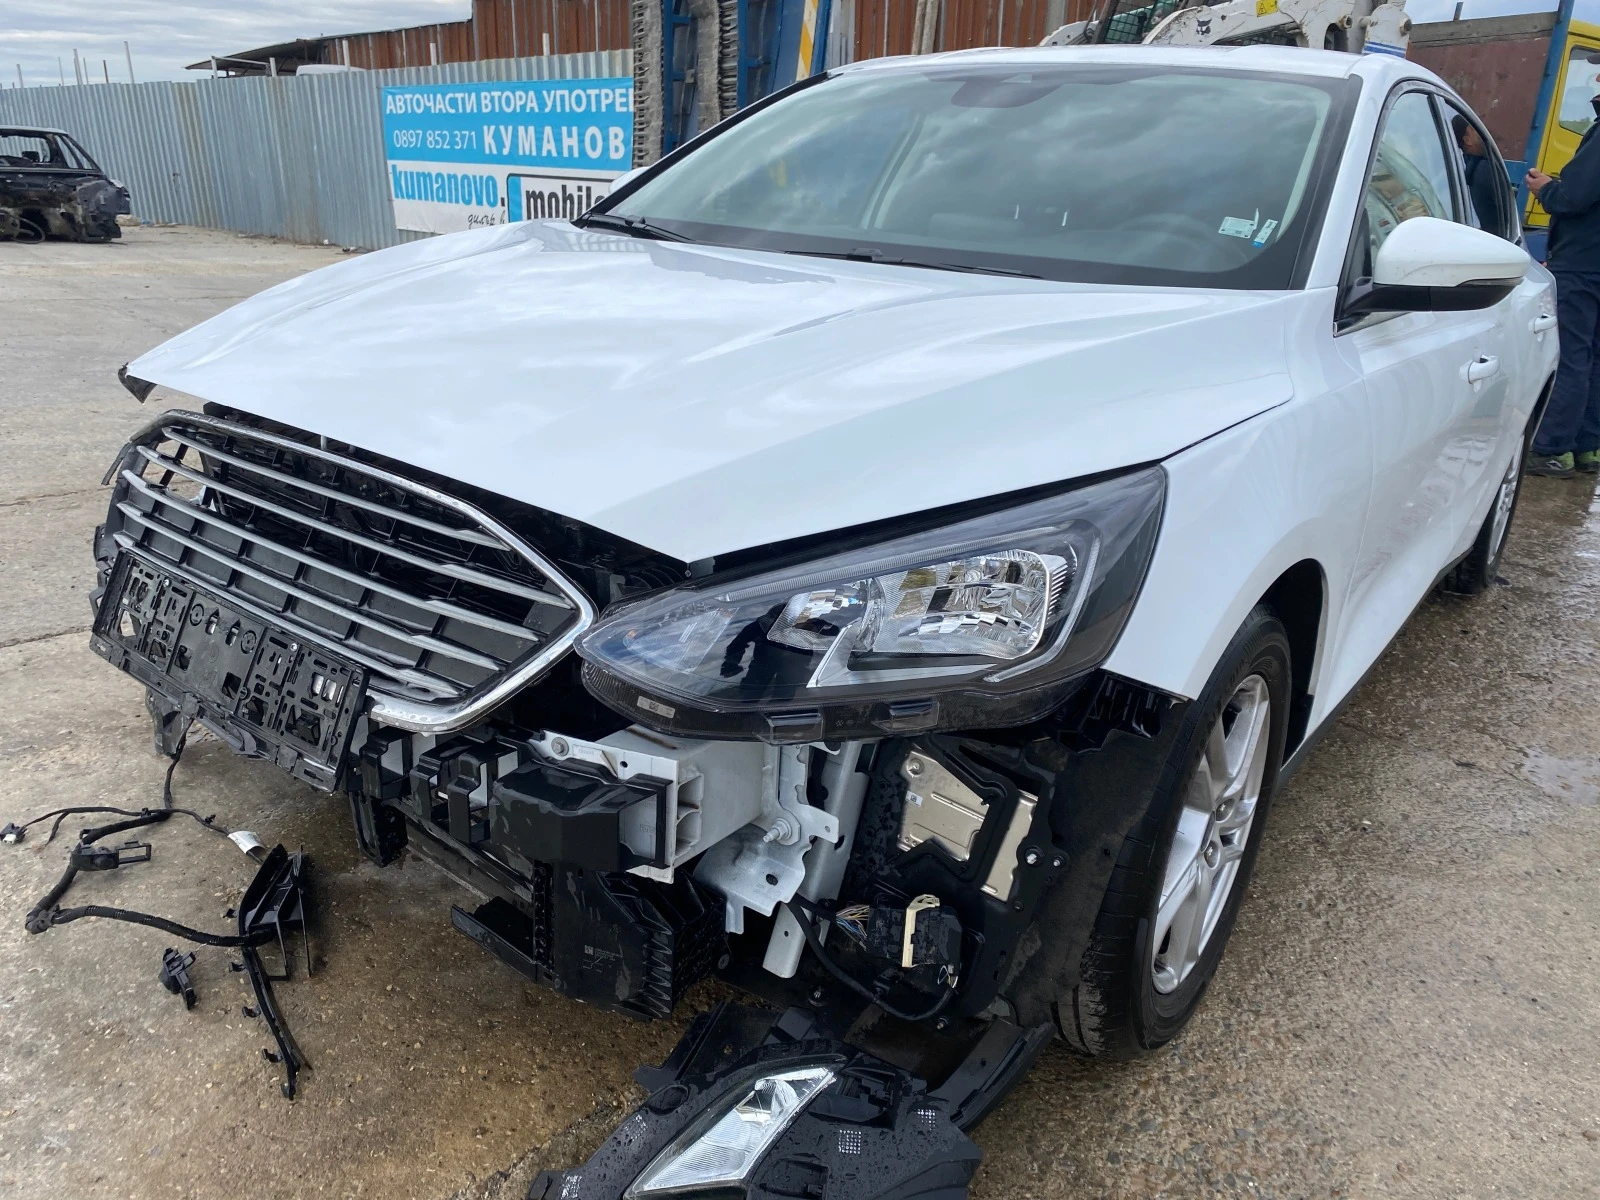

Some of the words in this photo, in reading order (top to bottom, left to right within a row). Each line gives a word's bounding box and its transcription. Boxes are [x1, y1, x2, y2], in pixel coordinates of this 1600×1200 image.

[386, 92, 477, 114] АВТОЧАСТИ
[481, 90, 539, 113] ВТОРА
[393, 130, 422, 148] 0897
[426, 130, 451, 148] 852
[453, 131, 477, 149] 371
[483, 125, 625, 160] КУМАНОВ
